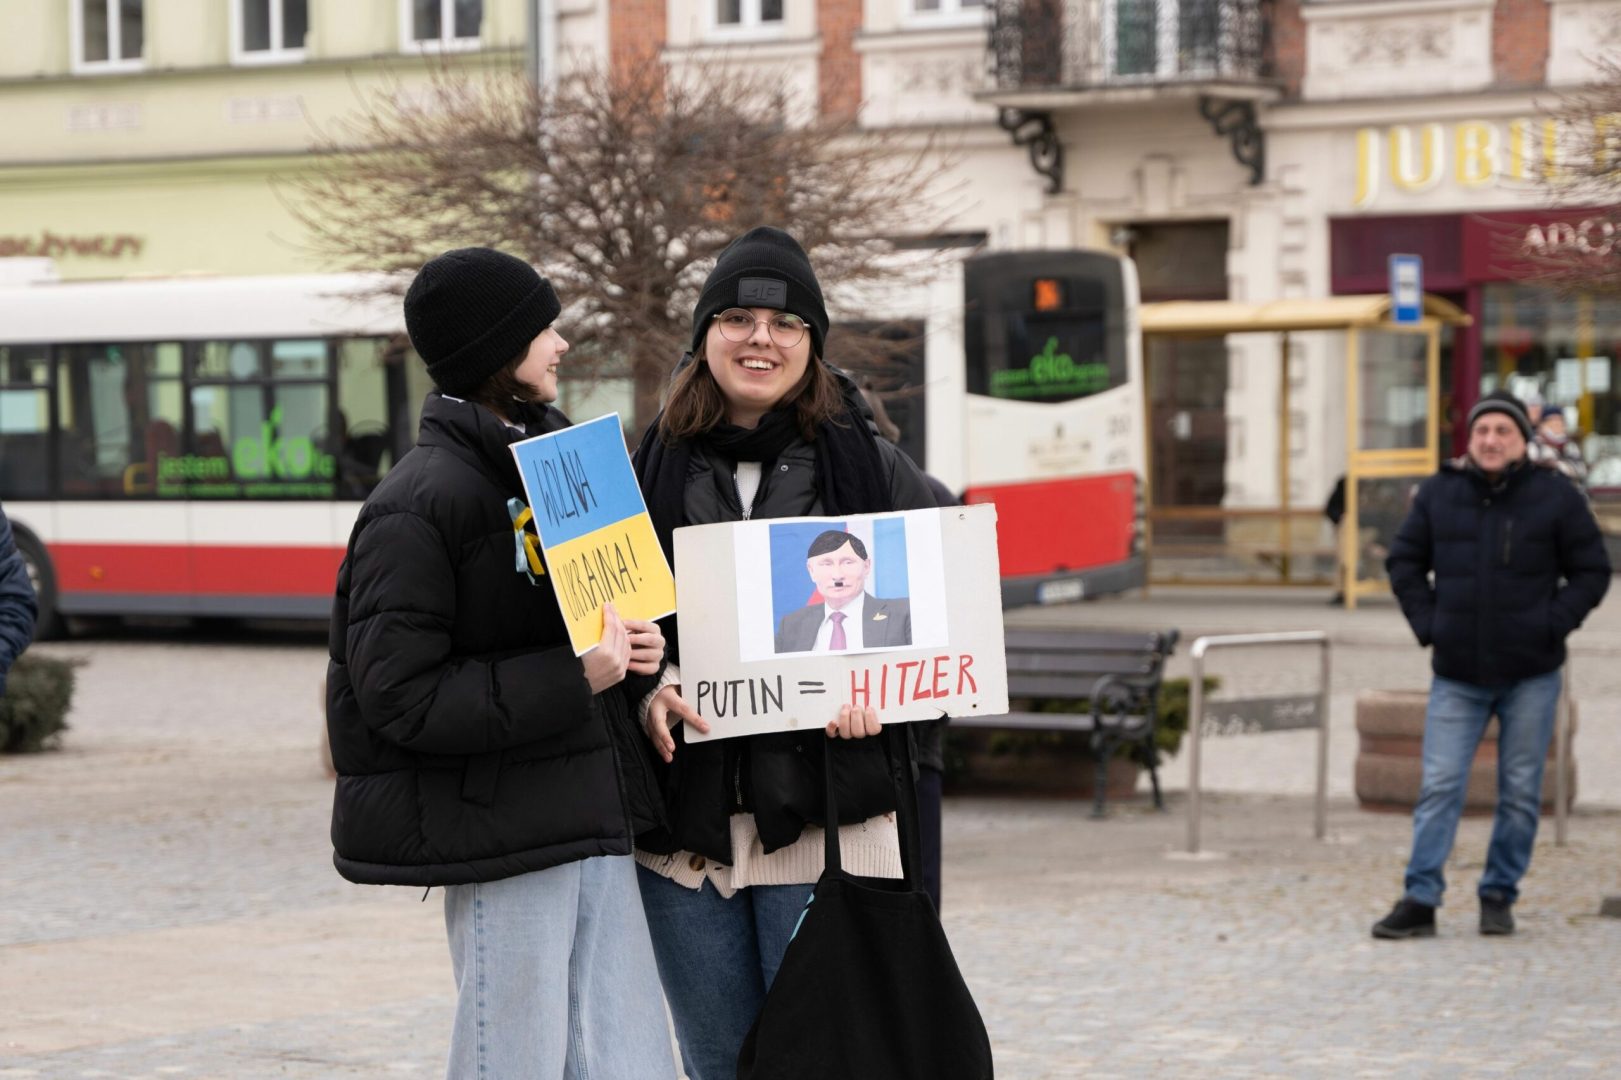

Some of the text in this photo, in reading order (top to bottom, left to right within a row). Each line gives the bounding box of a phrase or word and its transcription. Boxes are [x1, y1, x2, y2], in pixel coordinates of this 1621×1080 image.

[532, 434, 598, 528] WOLNA
[556, 533, 643, 622] UKRAINA!
[697, 674, 784, 718] PUTIN
[851, 654, 978, 710] HITLER
